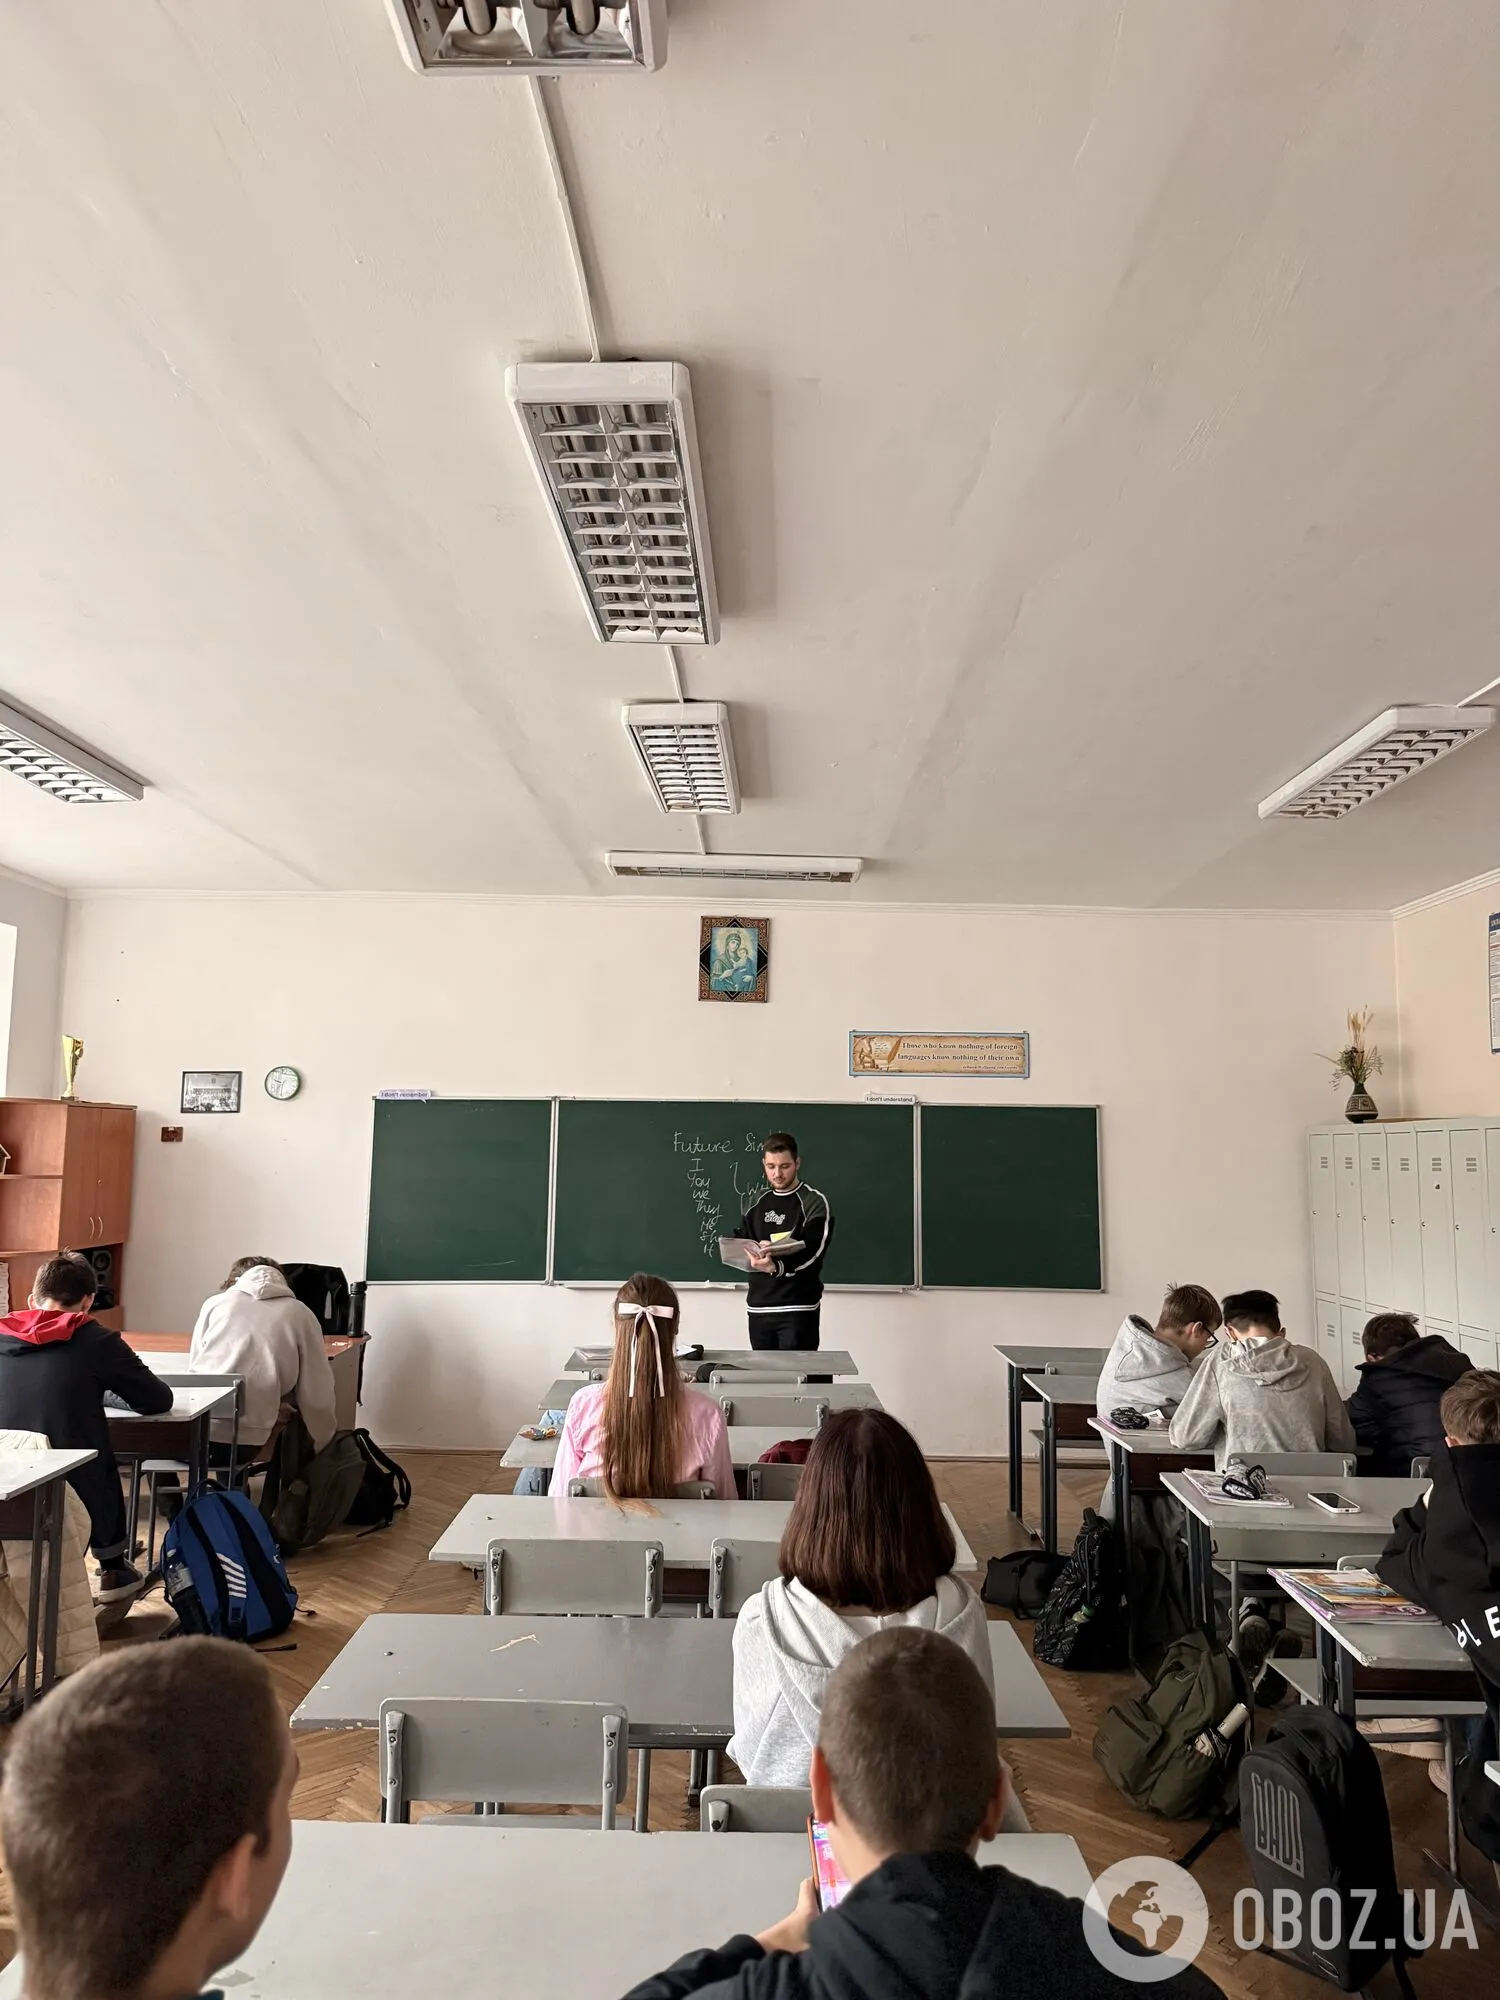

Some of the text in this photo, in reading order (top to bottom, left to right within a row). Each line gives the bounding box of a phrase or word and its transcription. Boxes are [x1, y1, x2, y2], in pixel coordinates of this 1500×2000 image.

[994, 1043, 1018, 1051] foreign
[898, 1053, 930, 1061] languages
[932, 1053, 950, 1061] know
[979, 1053, 987, 1061] of
[673, 1131, 735, 1153] Future
[688, 1158, 704, 1172] I
[686, 1172, 711, 1189] You
[695, 1199, 724, 1226] They
